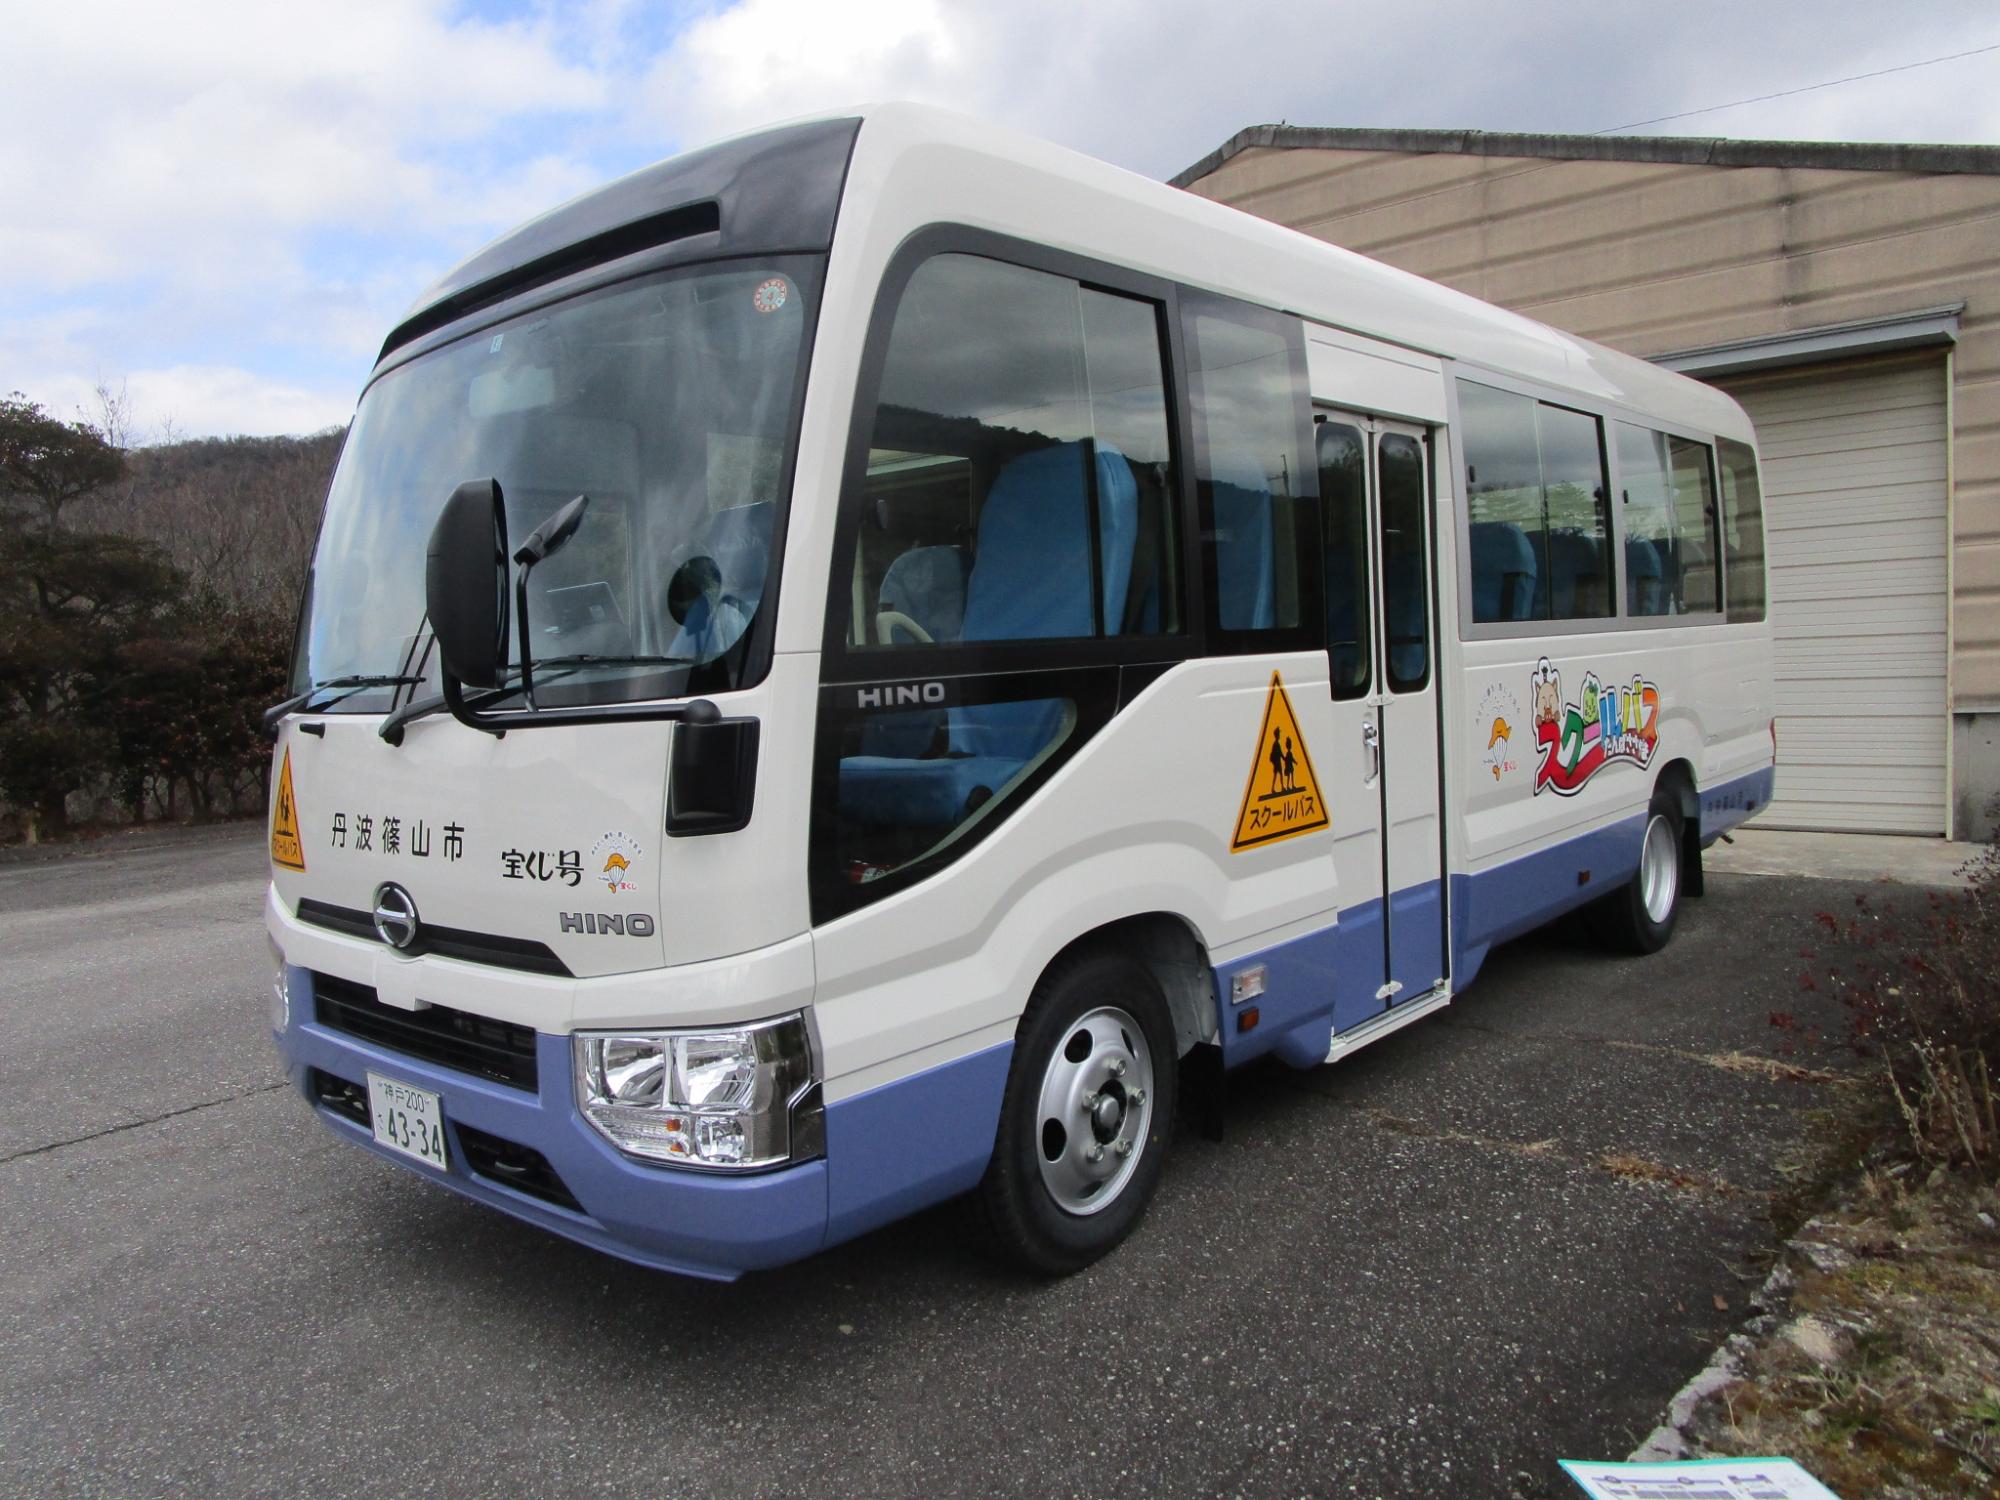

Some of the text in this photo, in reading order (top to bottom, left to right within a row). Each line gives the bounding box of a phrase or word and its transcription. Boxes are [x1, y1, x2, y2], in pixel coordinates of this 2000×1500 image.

[857, 682, 945, 709] HINO
[1250, 795, 1316, 831] スクールバス
[331, 811, 466, 863] 丹波篠山市
[501, 848, 585, 887] 宝くじ号
[559, 911, 655, 938] HINO
[388, 1107, 442, 1162] 43-34
